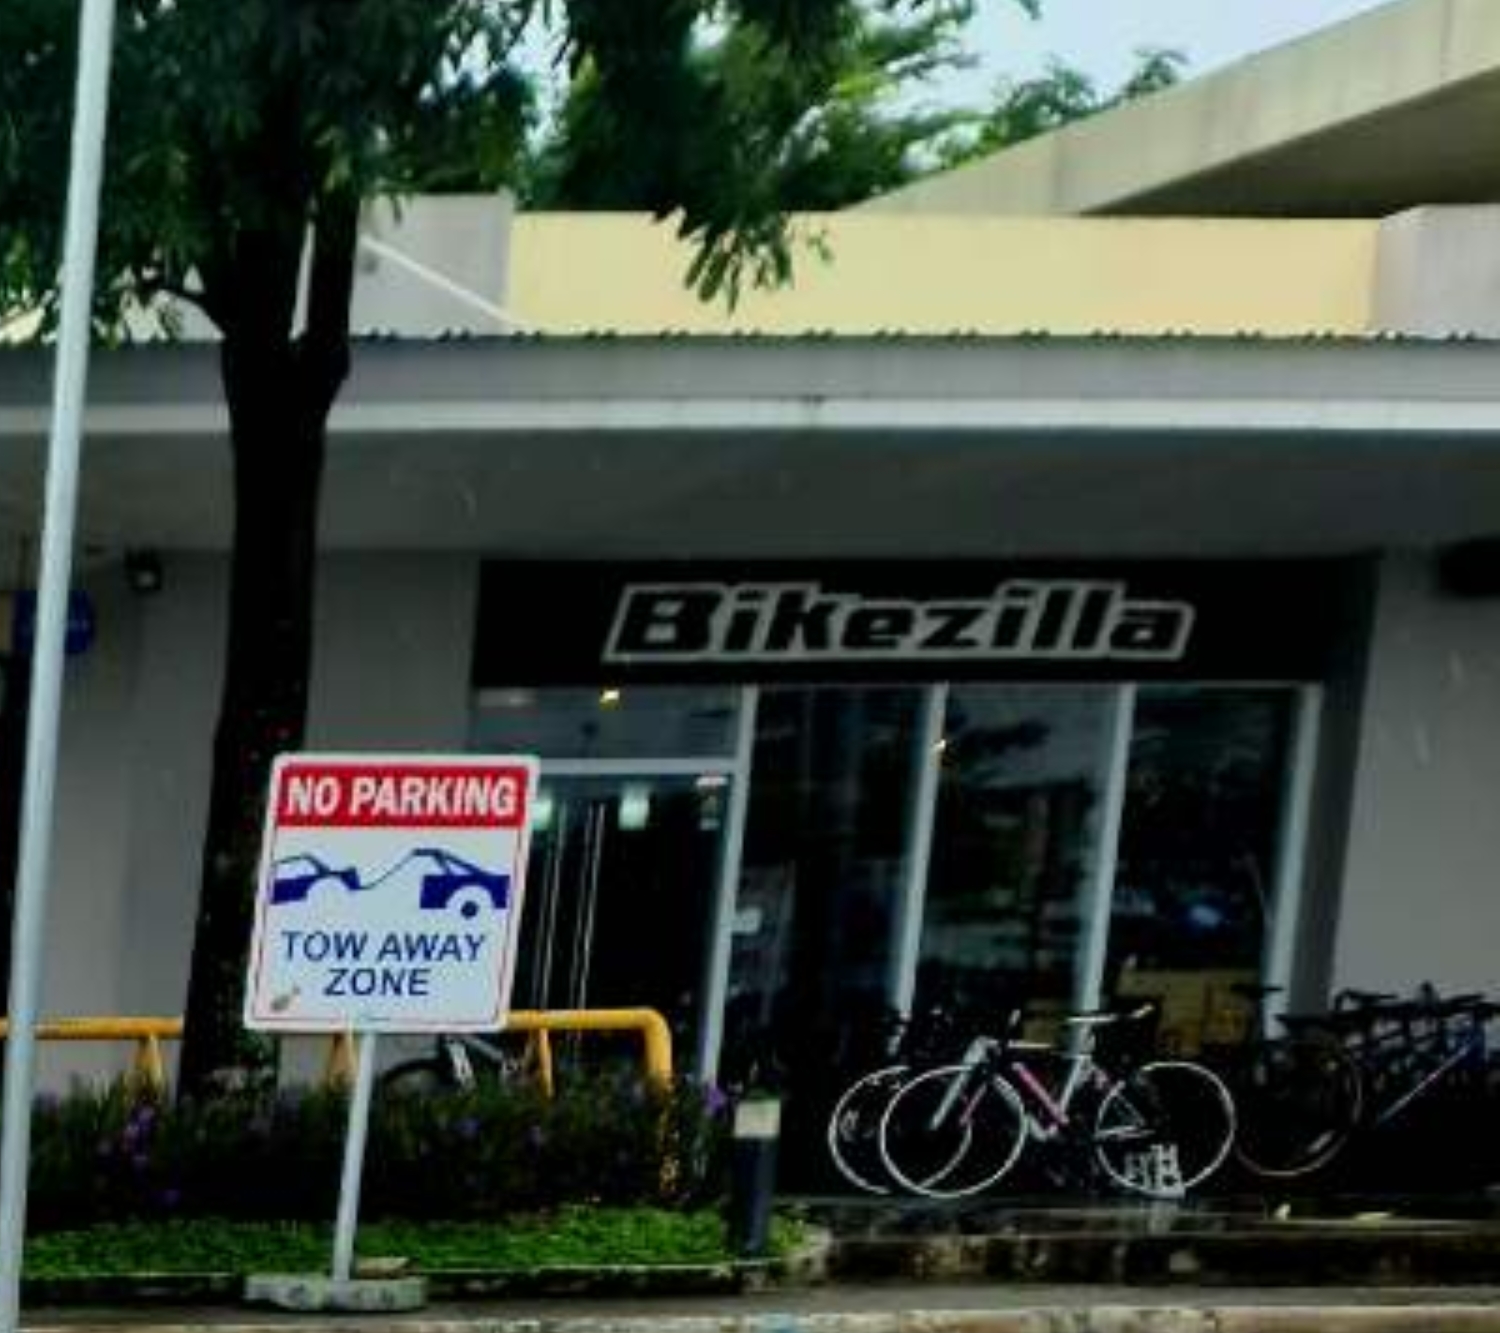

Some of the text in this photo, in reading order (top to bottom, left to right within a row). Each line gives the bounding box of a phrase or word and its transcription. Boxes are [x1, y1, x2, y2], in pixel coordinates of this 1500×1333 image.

[603, 580, 1196, 663] Bikezilla
[285, 776, 518, 817] NO PARKING
[280, 930, 486, 962] TOW AWAY
[323, 968, 431, 997] ZONE
